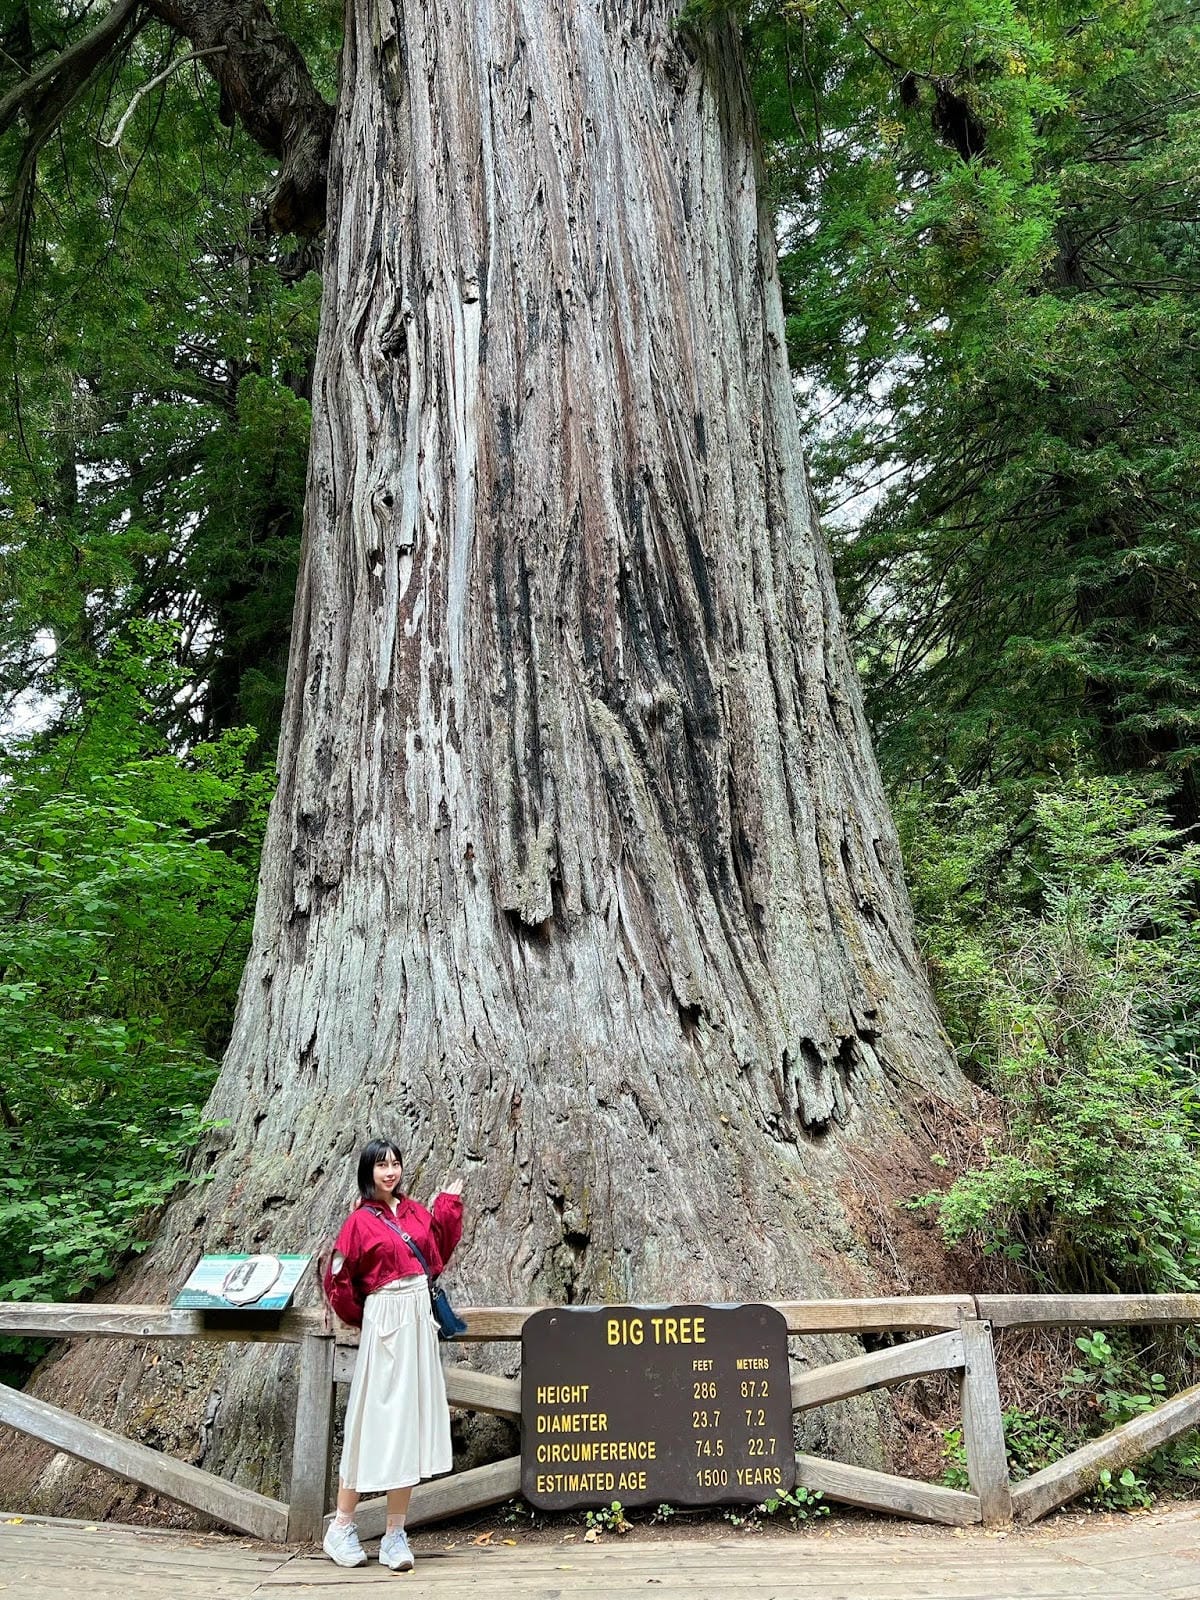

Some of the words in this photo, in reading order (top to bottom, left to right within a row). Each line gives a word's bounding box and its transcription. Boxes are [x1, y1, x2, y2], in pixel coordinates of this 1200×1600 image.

[608, 1319, 643, 1345] BIG
[651, 1318, 706, 1344] TREE
[693, 1360, 713, 1371] FEET
[737, 1358, 769, 1369] METERS
[538, 1385, 589, 1404] HEIGHT
[694, 1382, 716, 1399] 286
[739, 1381, 768, 1397] 87.2
[537, 1414, 607, 1433] DIAMETER
[693, 1411, 720, 1428] 23.7
[745, 1408, 765, 1426] 7.2
[537, 1441, 656, 1462] CIRCUMFERENCE
[696, 1440, 723, 1457] 74.5
[747, 1438, 775, 1456] 22.7
[537, 1473, 614, 1492] ESTIMATED
[619, 1472, 646, 1490] AGE
[697, 1469, 727, 1488] 1500
[736, 1466, 782, 1487] YEARS
